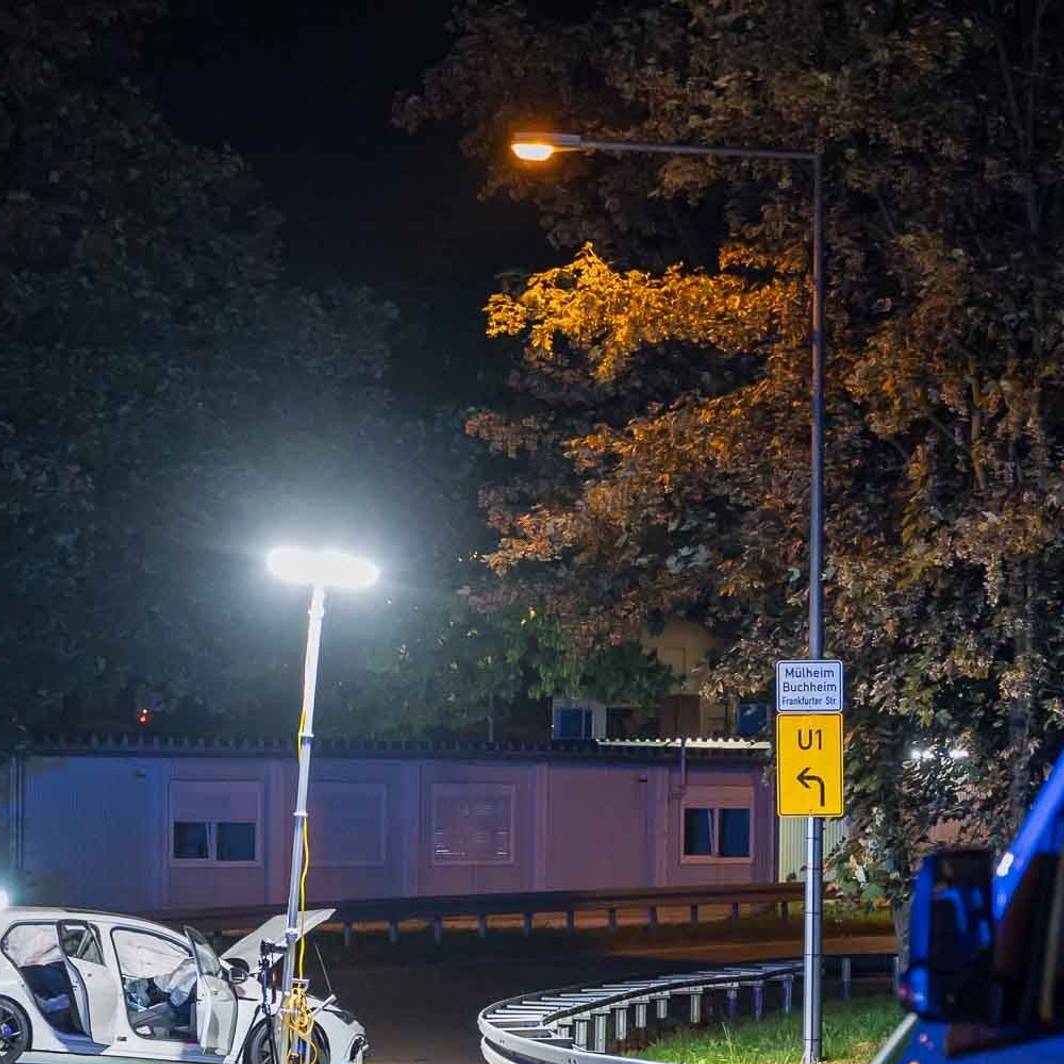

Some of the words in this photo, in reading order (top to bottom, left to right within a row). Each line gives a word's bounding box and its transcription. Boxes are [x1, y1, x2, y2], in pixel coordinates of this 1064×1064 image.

[785, 667, 834, 678] Mülheim
[783, 681, 837, 692] Buchheim
[782, 695, 823, 705] Frankfurter
[797, 729, 822, 750] U1
